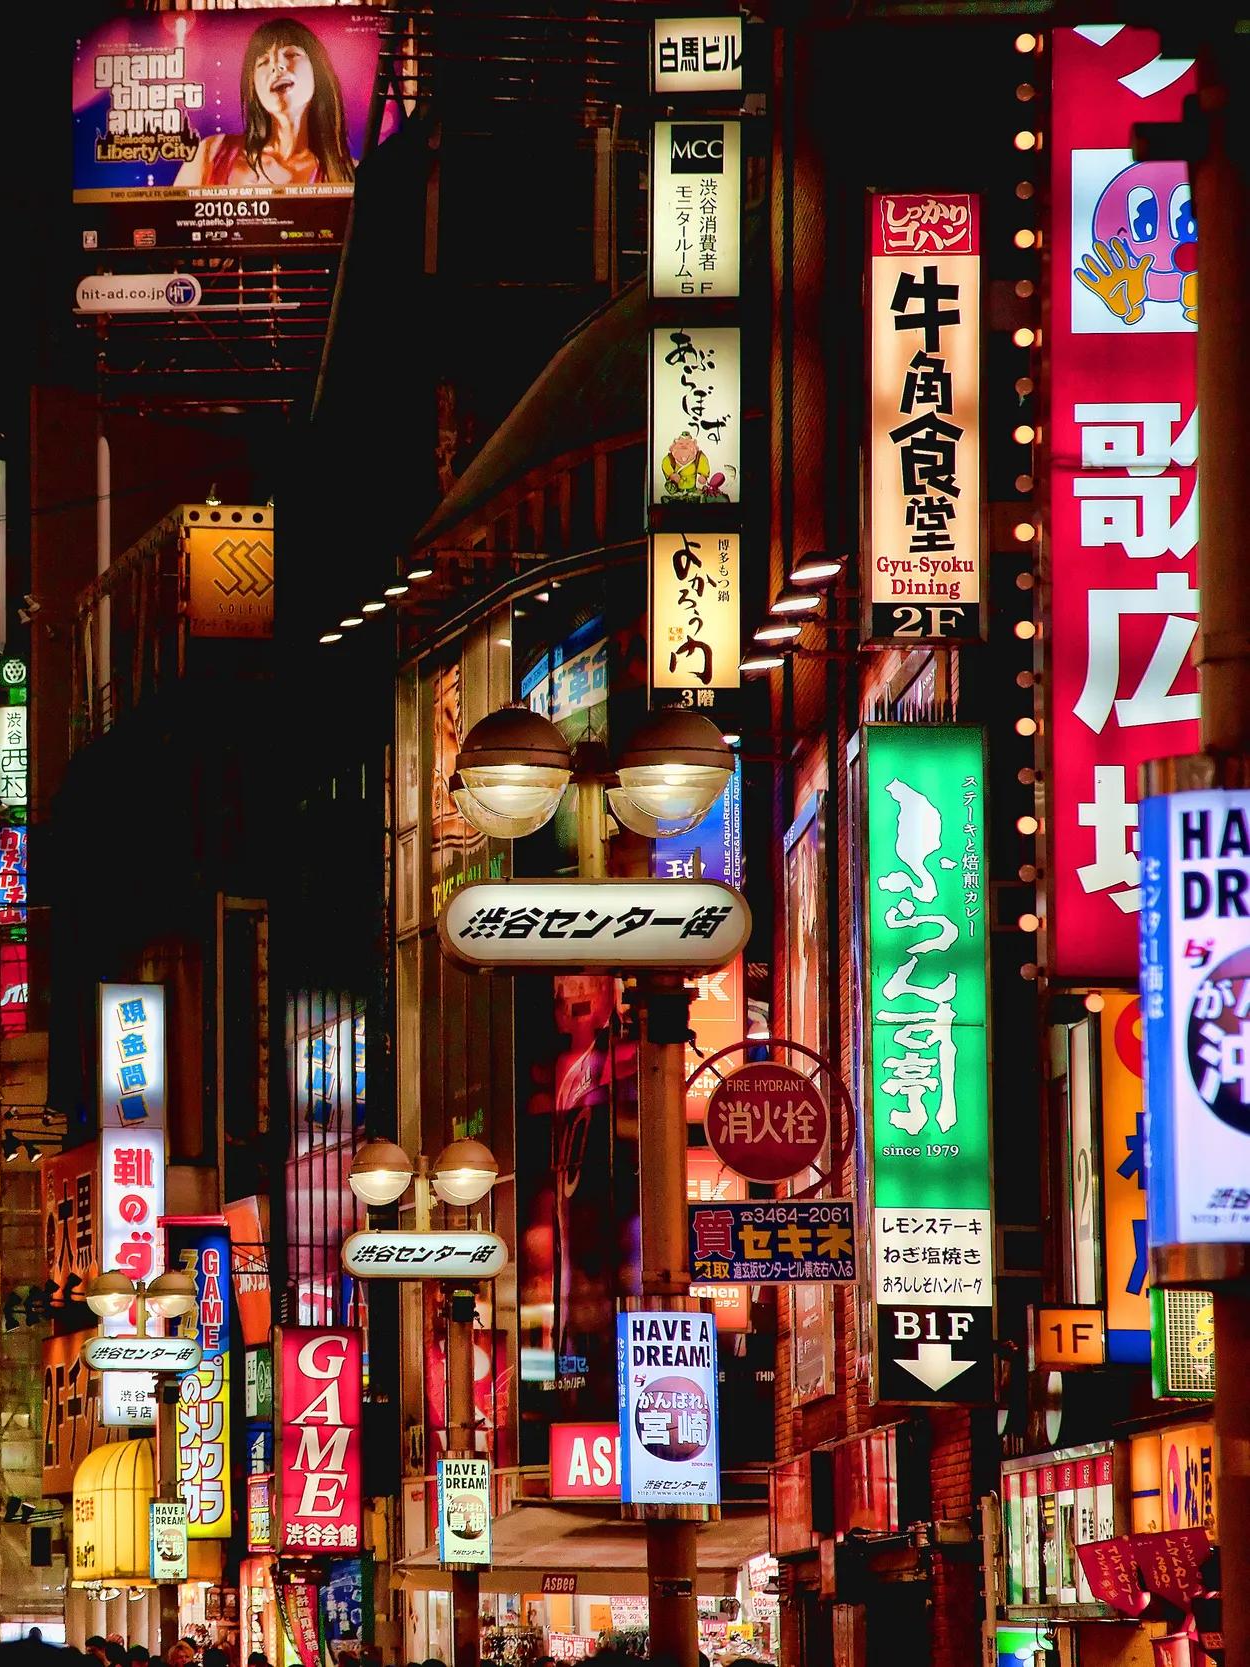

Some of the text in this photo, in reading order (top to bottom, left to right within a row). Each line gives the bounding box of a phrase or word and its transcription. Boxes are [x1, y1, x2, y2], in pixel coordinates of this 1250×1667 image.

[659, 35, 742, 73] 白馬ビル
[95, 48, 186, 88] grand
[111, 82, 204, 110] theft
[108, 109, 182, 134] auto
[96, 142, 197, 163] Liberty City
[672, 140, 724, 160] MCC
[195, 201, 270, 217] 2010.6.10
[885, 200, 968, 227] しっかり
[675, 186, 693, 278] モニタールーム
[699, 178, 717, 272] 渋谷消費者
[890, 225, 967, 251] ゴハン
[82, 284, 165, 300] hit-ad.co.jp
[681, 282, 713, 294] 5F
[889, 266, 965, 553] 牛角食堂
[877, 557, 974, 577] Gyu-Syoku
[891, 579, 961, 600] Dining
[892, 606, 965, 638] 2F
[682, 689, 715, 708] 3階
[961, 775, 980, 937] ステーキと焙煎カレー
[458, 906, 733, 939] 渋谷センター街
[726, 1080, 806, 1092] FIRE HYDRANT
[718, 1100, 817, 1144] 消火栓
[883, 1145, 959, 1157] since 1979
[754, 1207, 849, 1223] 3464-2061
[882, 1217, 982, 1235] レモンステーキ
[693, 1210, 736, 1260] 質
[738, 1225, 853, 1259] セキネ
[352, 1245, 497, 1263] 渋谷センター街
[883, 1247, 981, 1265] ねぎ塩焼き
[882, 1277, 982, 1294] おろししそハンバーグ
[201, 1248, 223, 1350] GAME
[632, 1320, 709, 1343] HAVE A
[894, 1311, 974, 1340] B1F
[1050, 1323, 1093, 1354] 1F
[92, 1346, 194, 1361] 渋谷センター街
[633, 1345, 711, 1368] DREAM!
[638, 1392, 709, 1411] がんばれ!
[289, 1335, 355, 1518] GAME
[638, 1411, 708, 1446] 宮崎
[199, 1358, 224, 1526] プリクラ
[446, 1464, 487, 1476] HAVE A
[446, 1477, 487, 1490] DREAM!
[155, 1506, 178, 1515] HAVE
[286, 1523, 358, 1547] 渋谷会館
